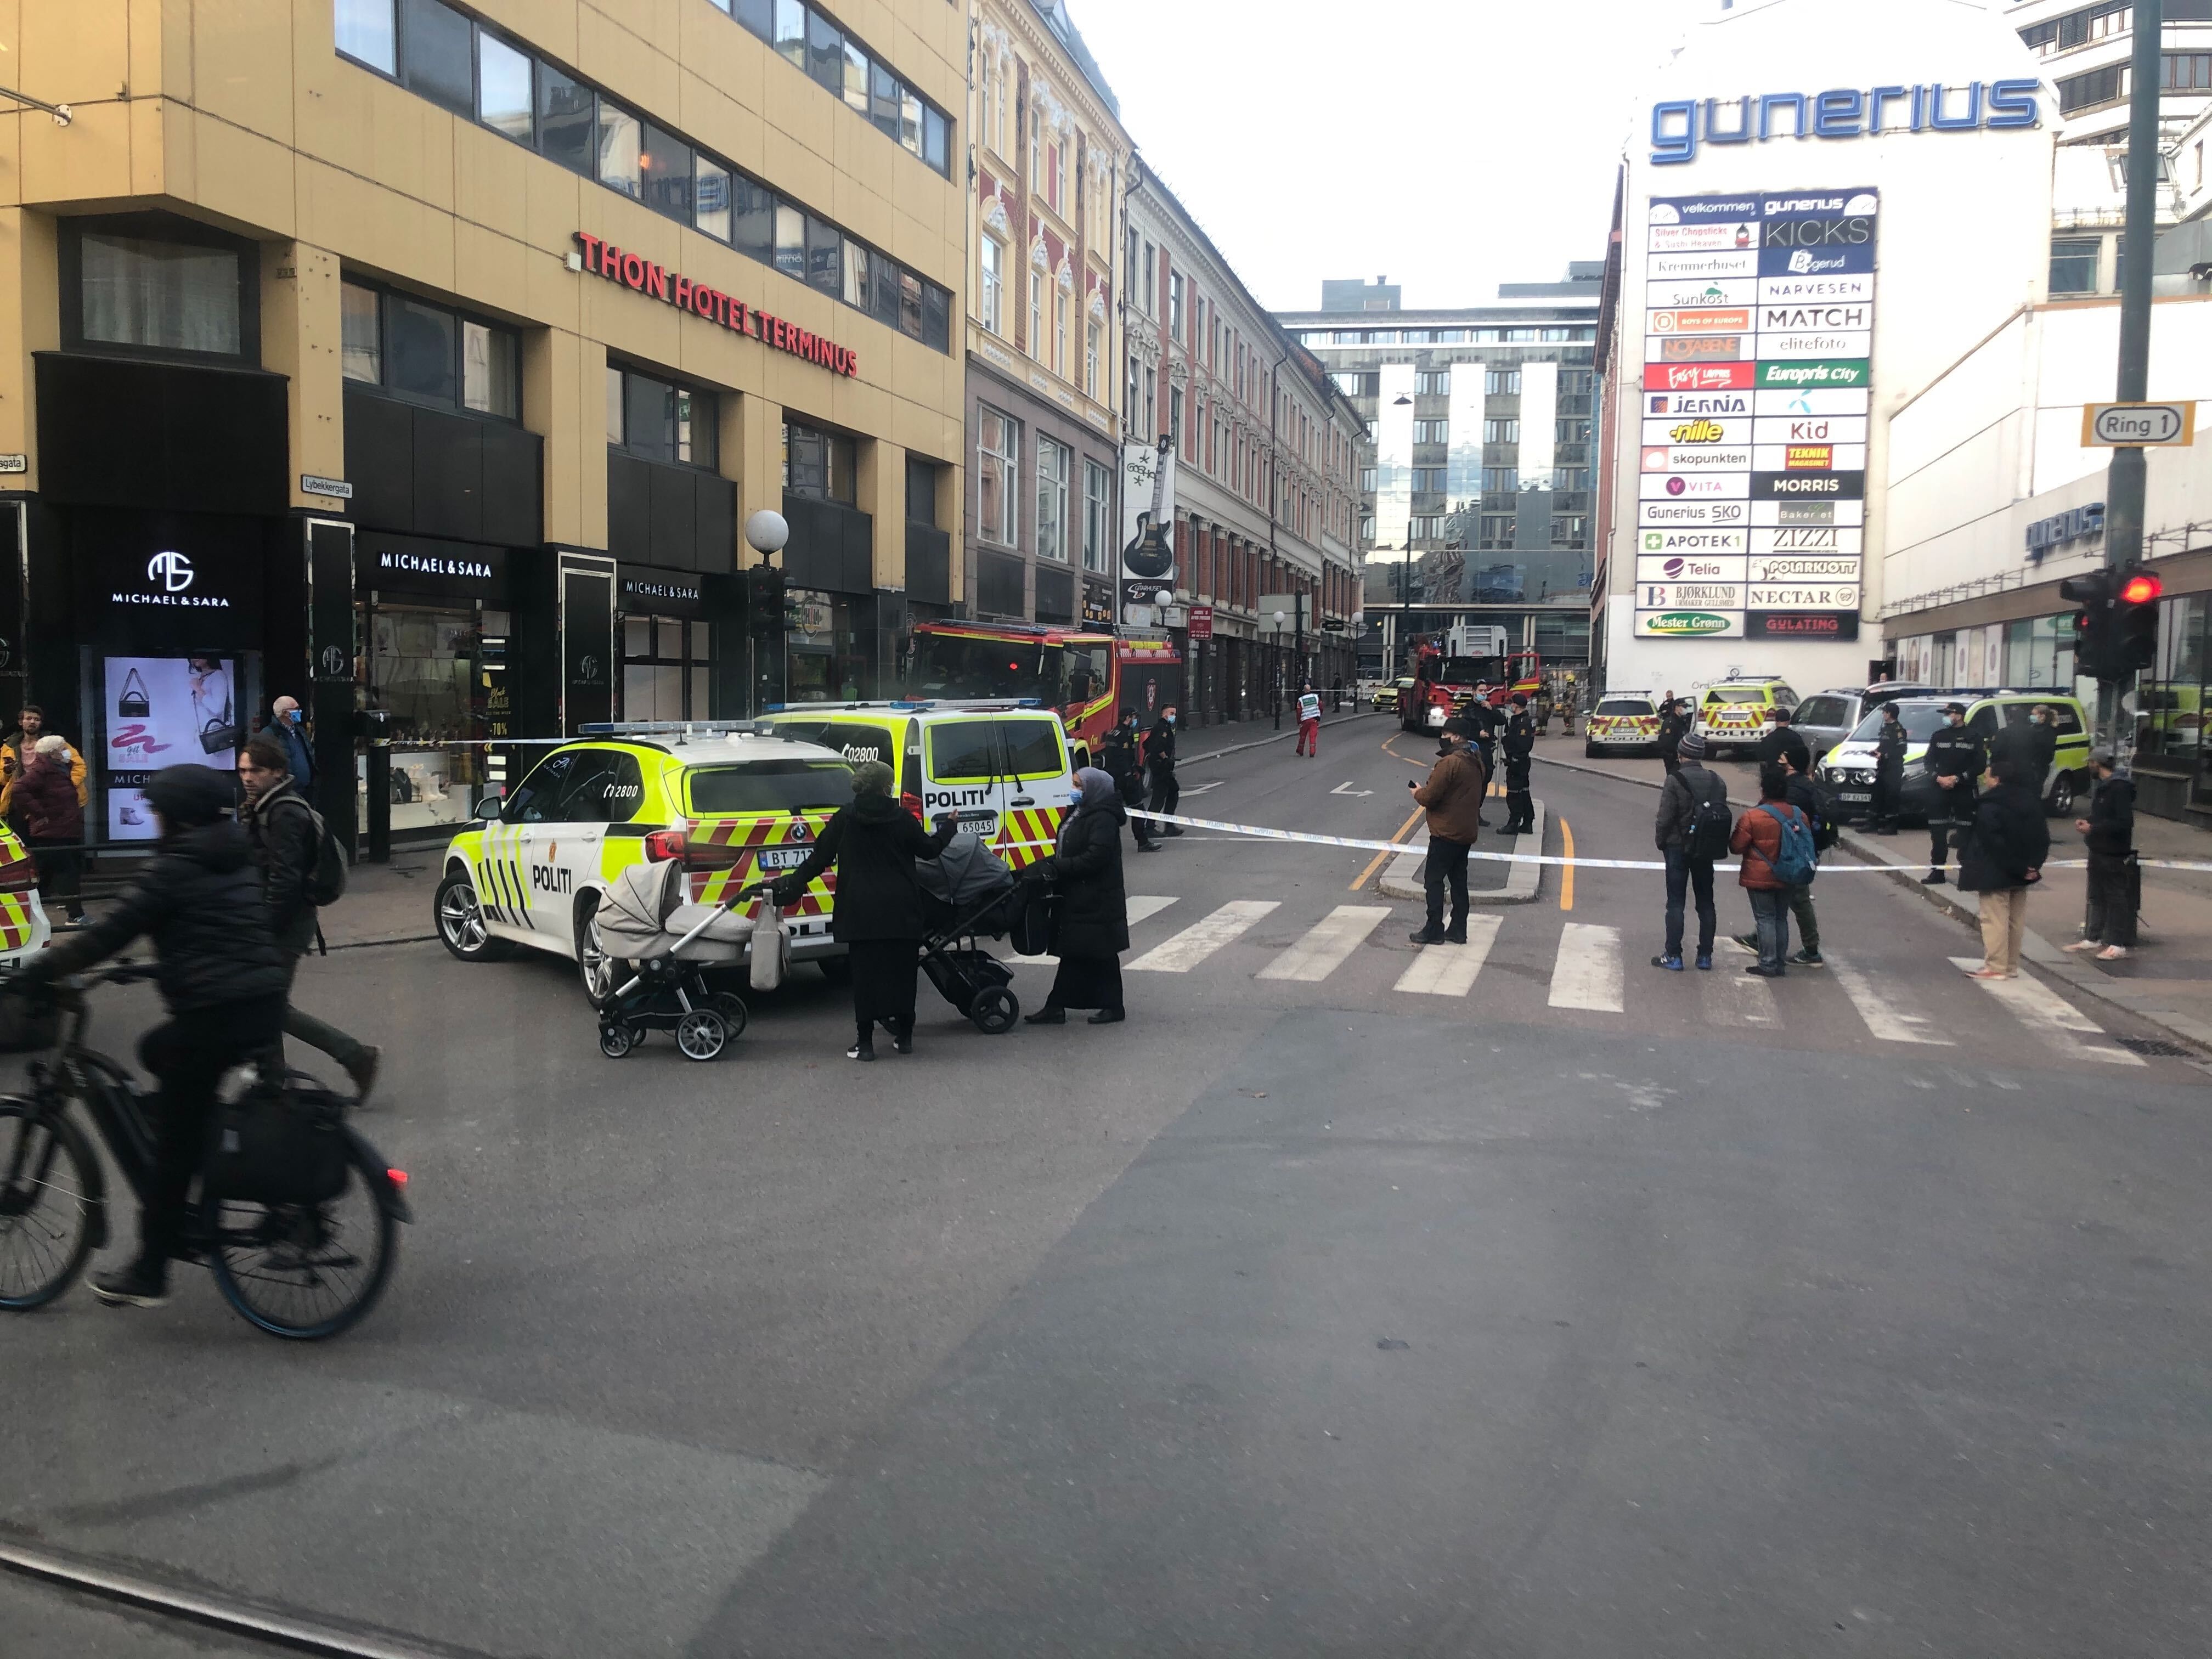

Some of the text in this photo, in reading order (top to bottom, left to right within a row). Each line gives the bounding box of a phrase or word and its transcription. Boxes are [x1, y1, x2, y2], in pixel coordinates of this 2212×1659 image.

[1650, 78, 2039, 165] gunerius
[1682, 202, 1754, 213] velkommen
[1764, 198, 1843, 215] gunerius
[1656, 227, 1727, 236] Silver Chopsticks
[1766, 218, 1869, 246] KICKS
[1658, 259, 1746, 271] Kremmerhuset
[1770, 283, 1861, 296] NARVESEN
[578, 232, 857, 378] THON HOTEL TERMINUS
[1673, 293, 1729, 305] Sunkost
[1767, 309, 1863, 327] MATCH
[1780, 336, 1846, 350] elitefoto
[1668, 367, 1701, 388] Easy
[1766, 365, 1860, 384] Europris City
[1791, 421, 1828, 439] Kid
[2106, 415, 2169, 437] Ring 1
[1673, 453, 1746, 466] skopunkten
[1788, 448, 1831, 459] TEKNIK
[306, 478, 349, 494] Lybekkergata
[1689, 482, 1722, 491] VITA
[1774, 479, 1839, 492] MORRIS
[1647, 505, 1741, 518] Gunerius SKO
[1666, 535, 1740, 547] APOTEK 1
[1773, 529, 1839, 547] ZIZZI
[1688, 563, 1720, 575] Telia
[1768, 561, 1857, 574] POLARKJØTT
[1676, 586, 1735, 600] BJØRKLUND
[1751, 591, 1831, 603] NECTAR
[1652, 616, 1725, 628] Mester Grønn
[487, 697, 509, 708] SALE
[489, 722, 507, 735] -70%
[925, 789, 984, 809] POLITI
[962, 821, 991, 833] 65045
[771, 851, 787, 865] BT
[532, 865, 572, 895] POLITI
